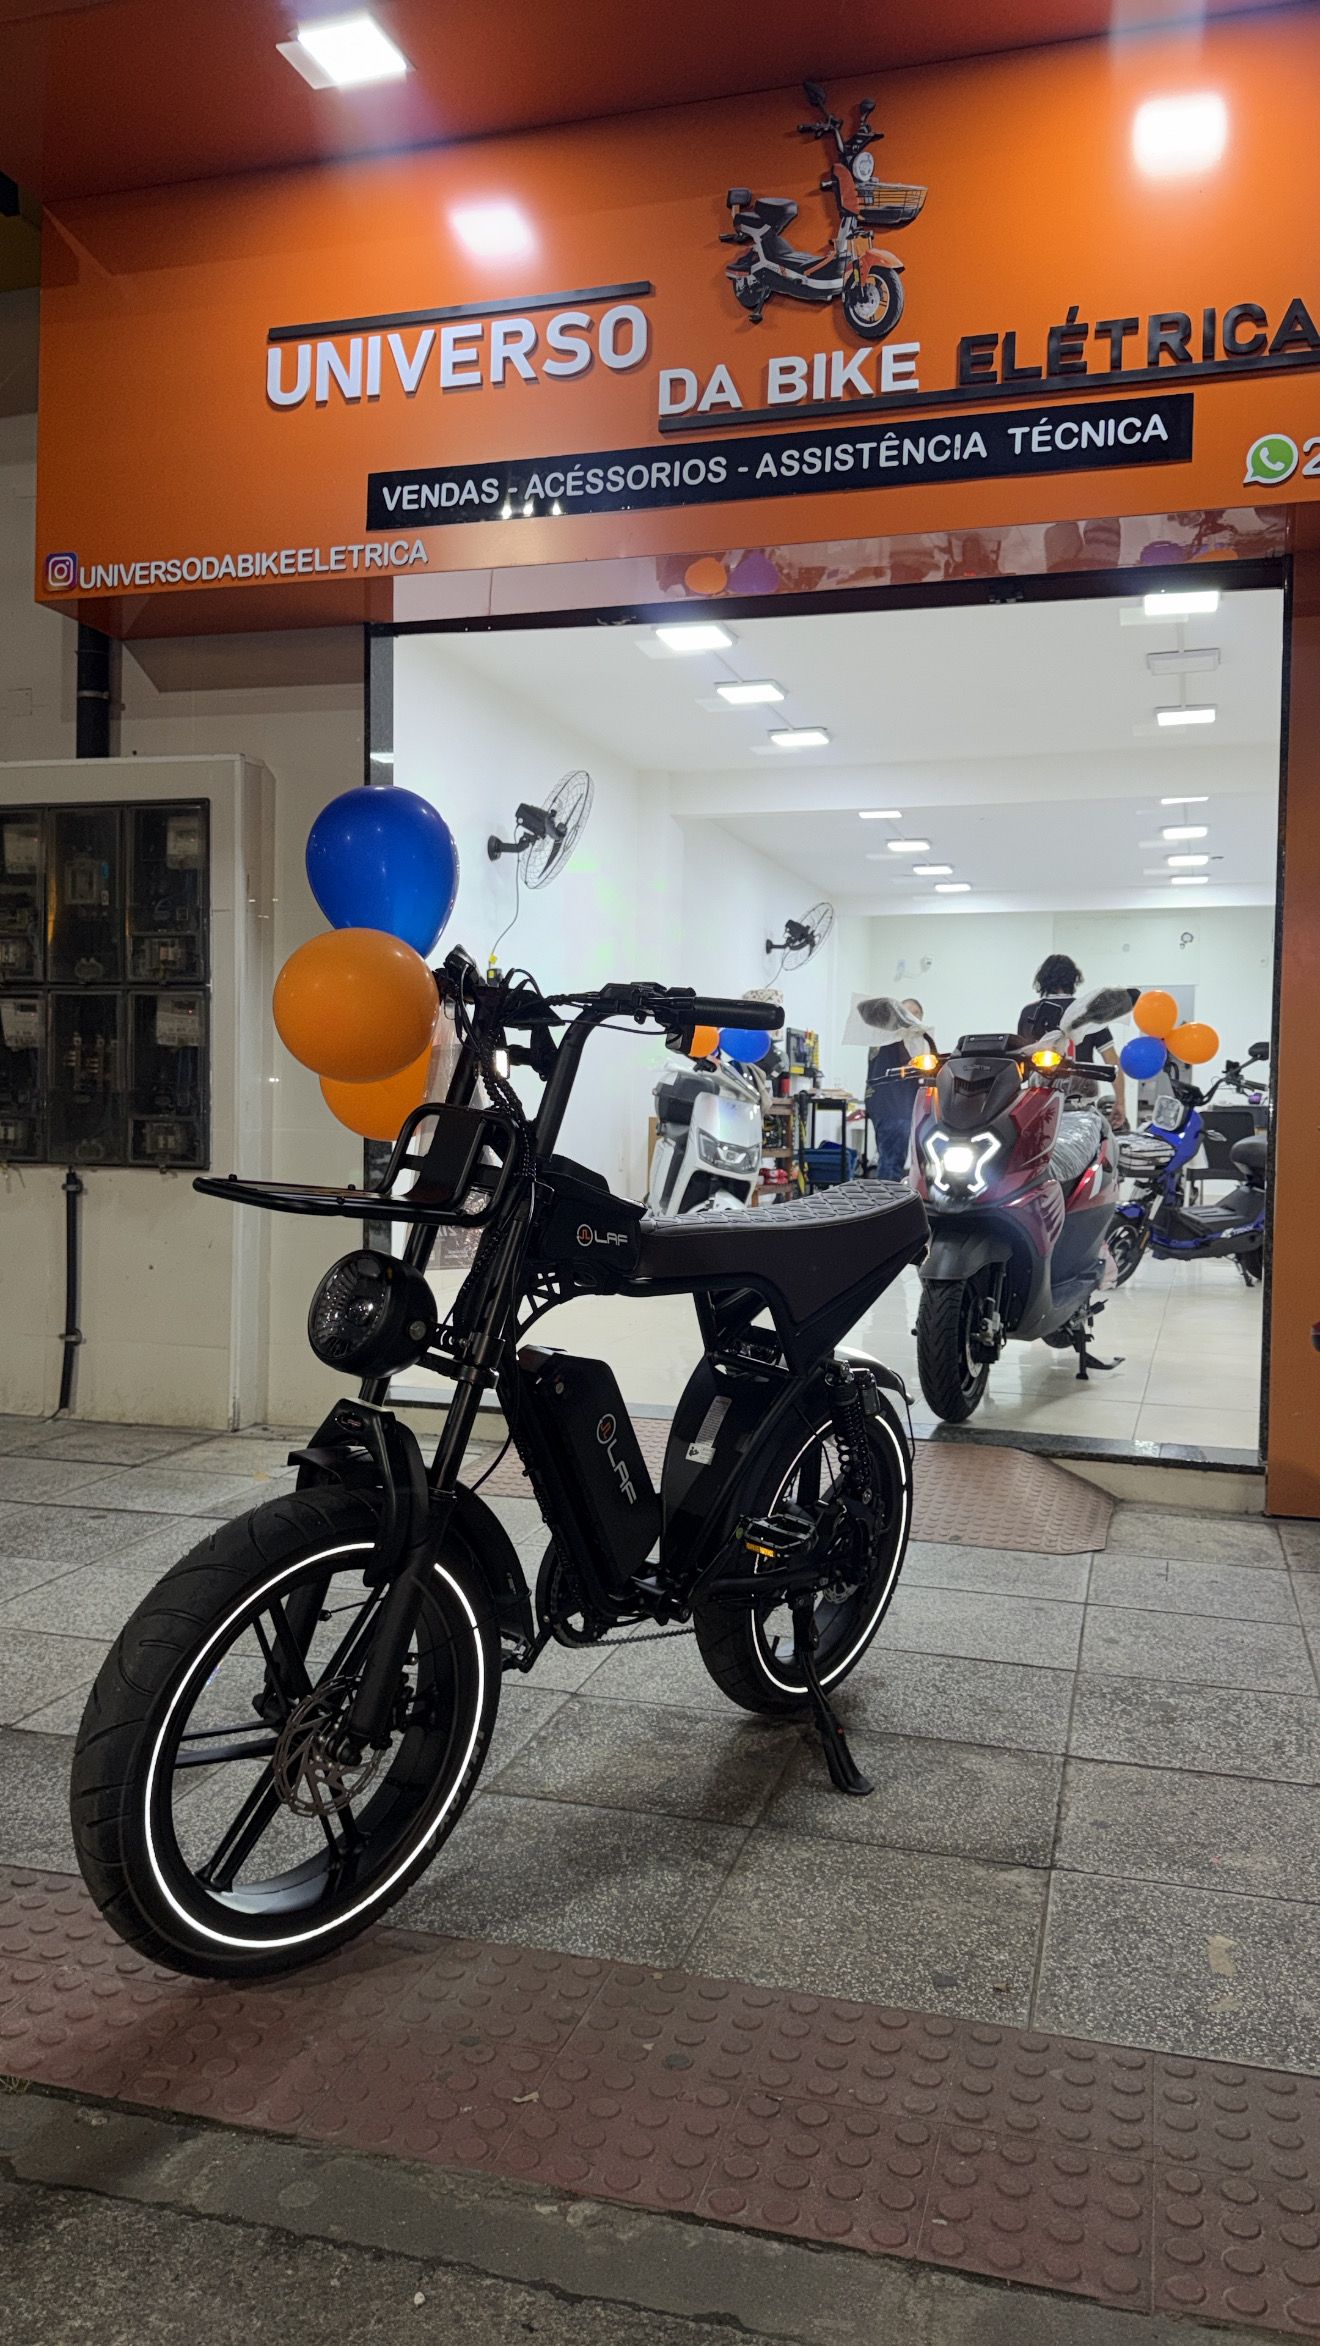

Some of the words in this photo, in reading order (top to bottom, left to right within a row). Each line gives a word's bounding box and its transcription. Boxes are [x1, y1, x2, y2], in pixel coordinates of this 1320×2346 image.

[266, 304, 649, 407] UNIVERSO
[658, 363, 743, 416] DA
[767, 341, 921, 405] BIKE
[959, 297, 1320, 386] ELÉTRICA
[382, 478, 500, 512] VENDAS
[524, 456, 728, 501] ACÉSSORIOS
[755, 431, 988, 480] ASSISTÊNCIA
[1007, 413, 1169, 456] TÉCNICA
[79, 538, 429, 590] UNIVERSODABIKEELETRICA
